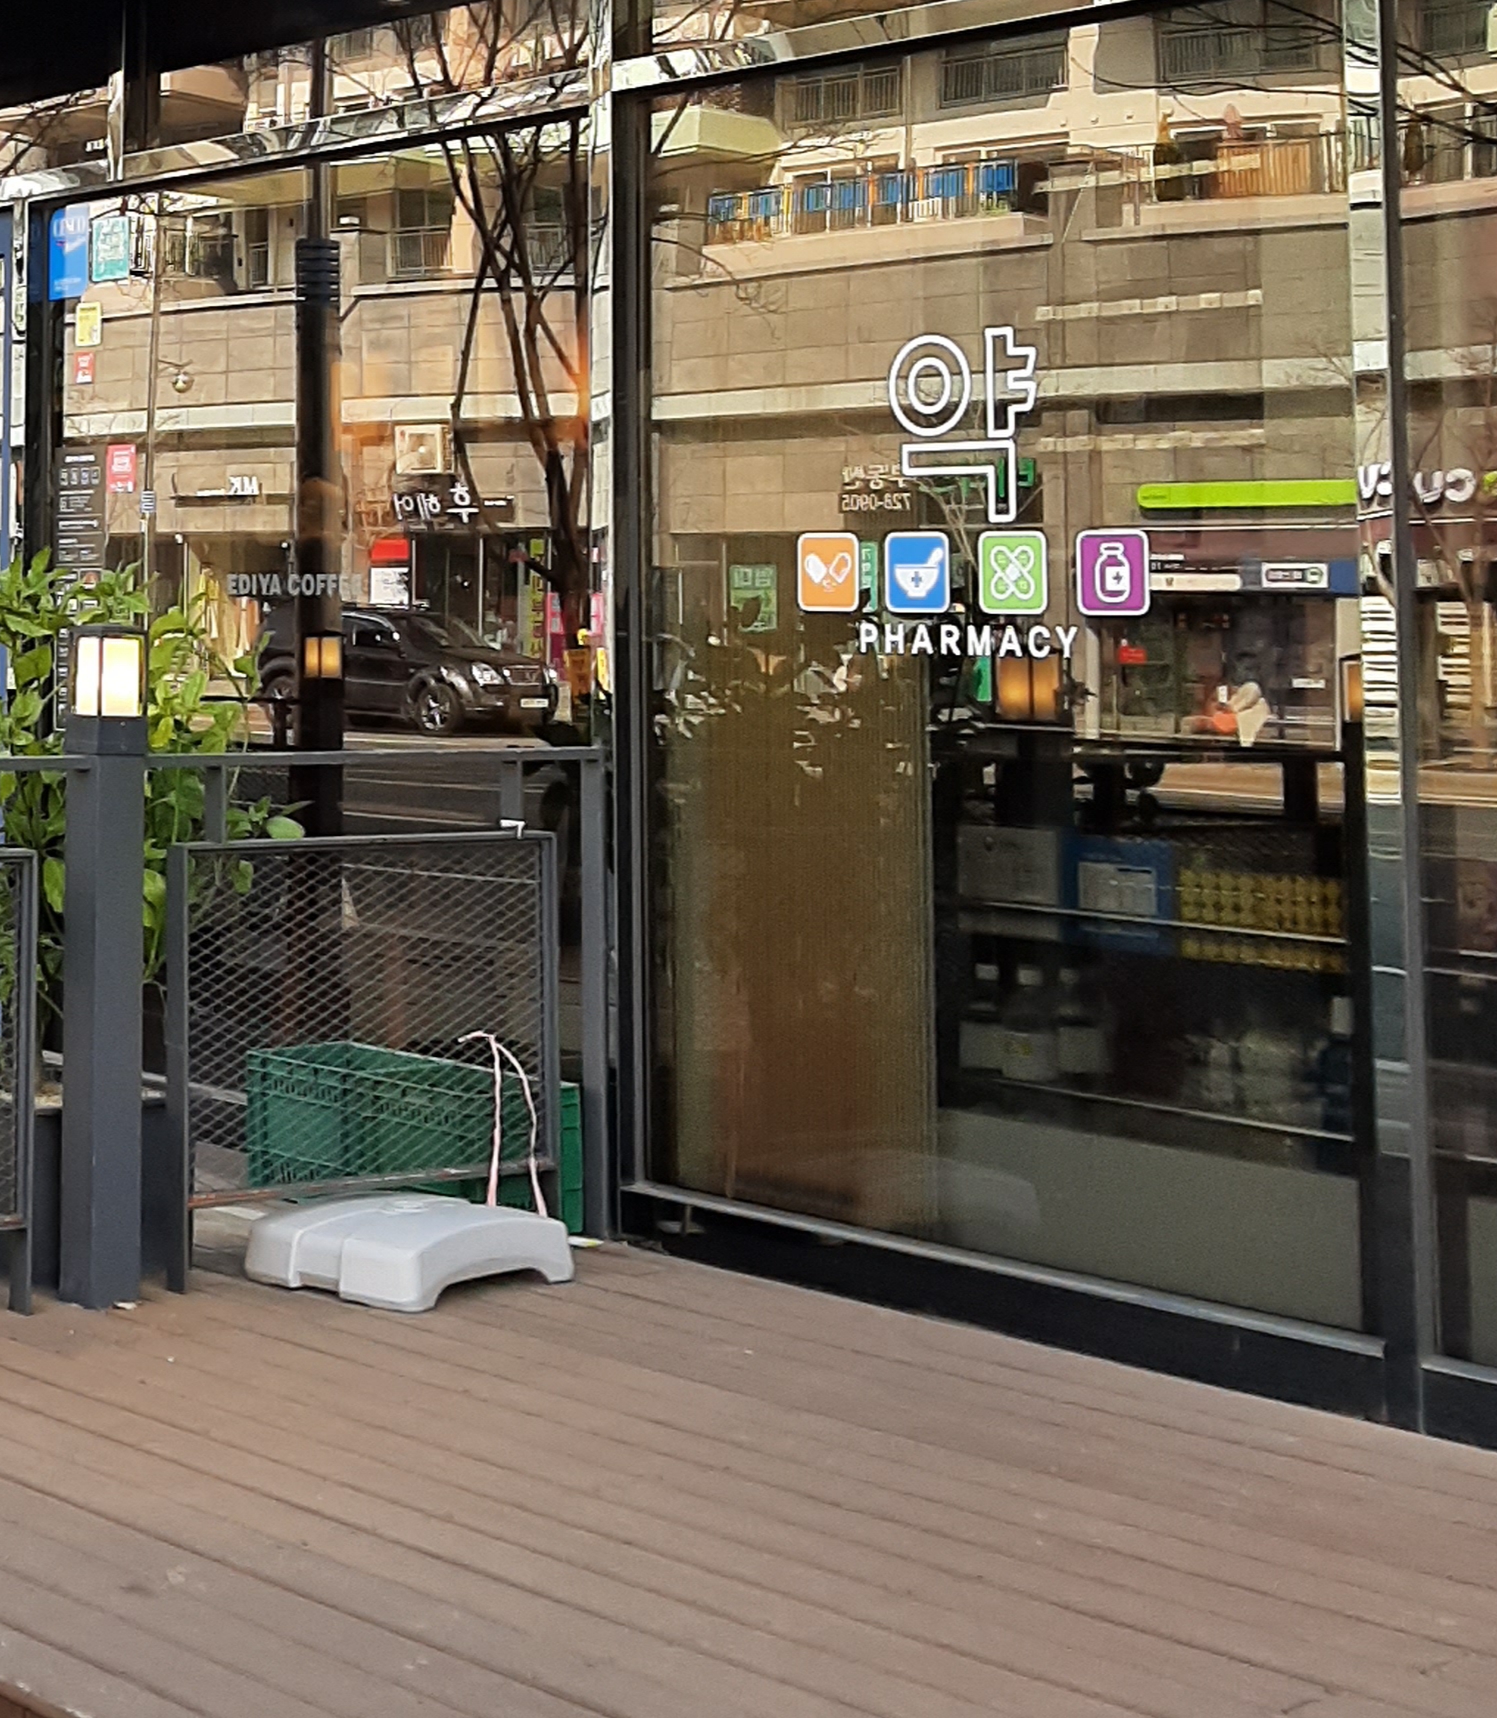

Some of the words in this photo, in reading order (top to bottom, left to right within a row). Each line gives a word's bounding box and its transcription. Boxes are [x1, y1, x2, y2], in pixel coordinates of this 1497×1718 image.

[886, 325, 1038, 524] 약
[226, 573, 282, 596] EDIYA
[858, 624, 1080, 659] PHARMACY
